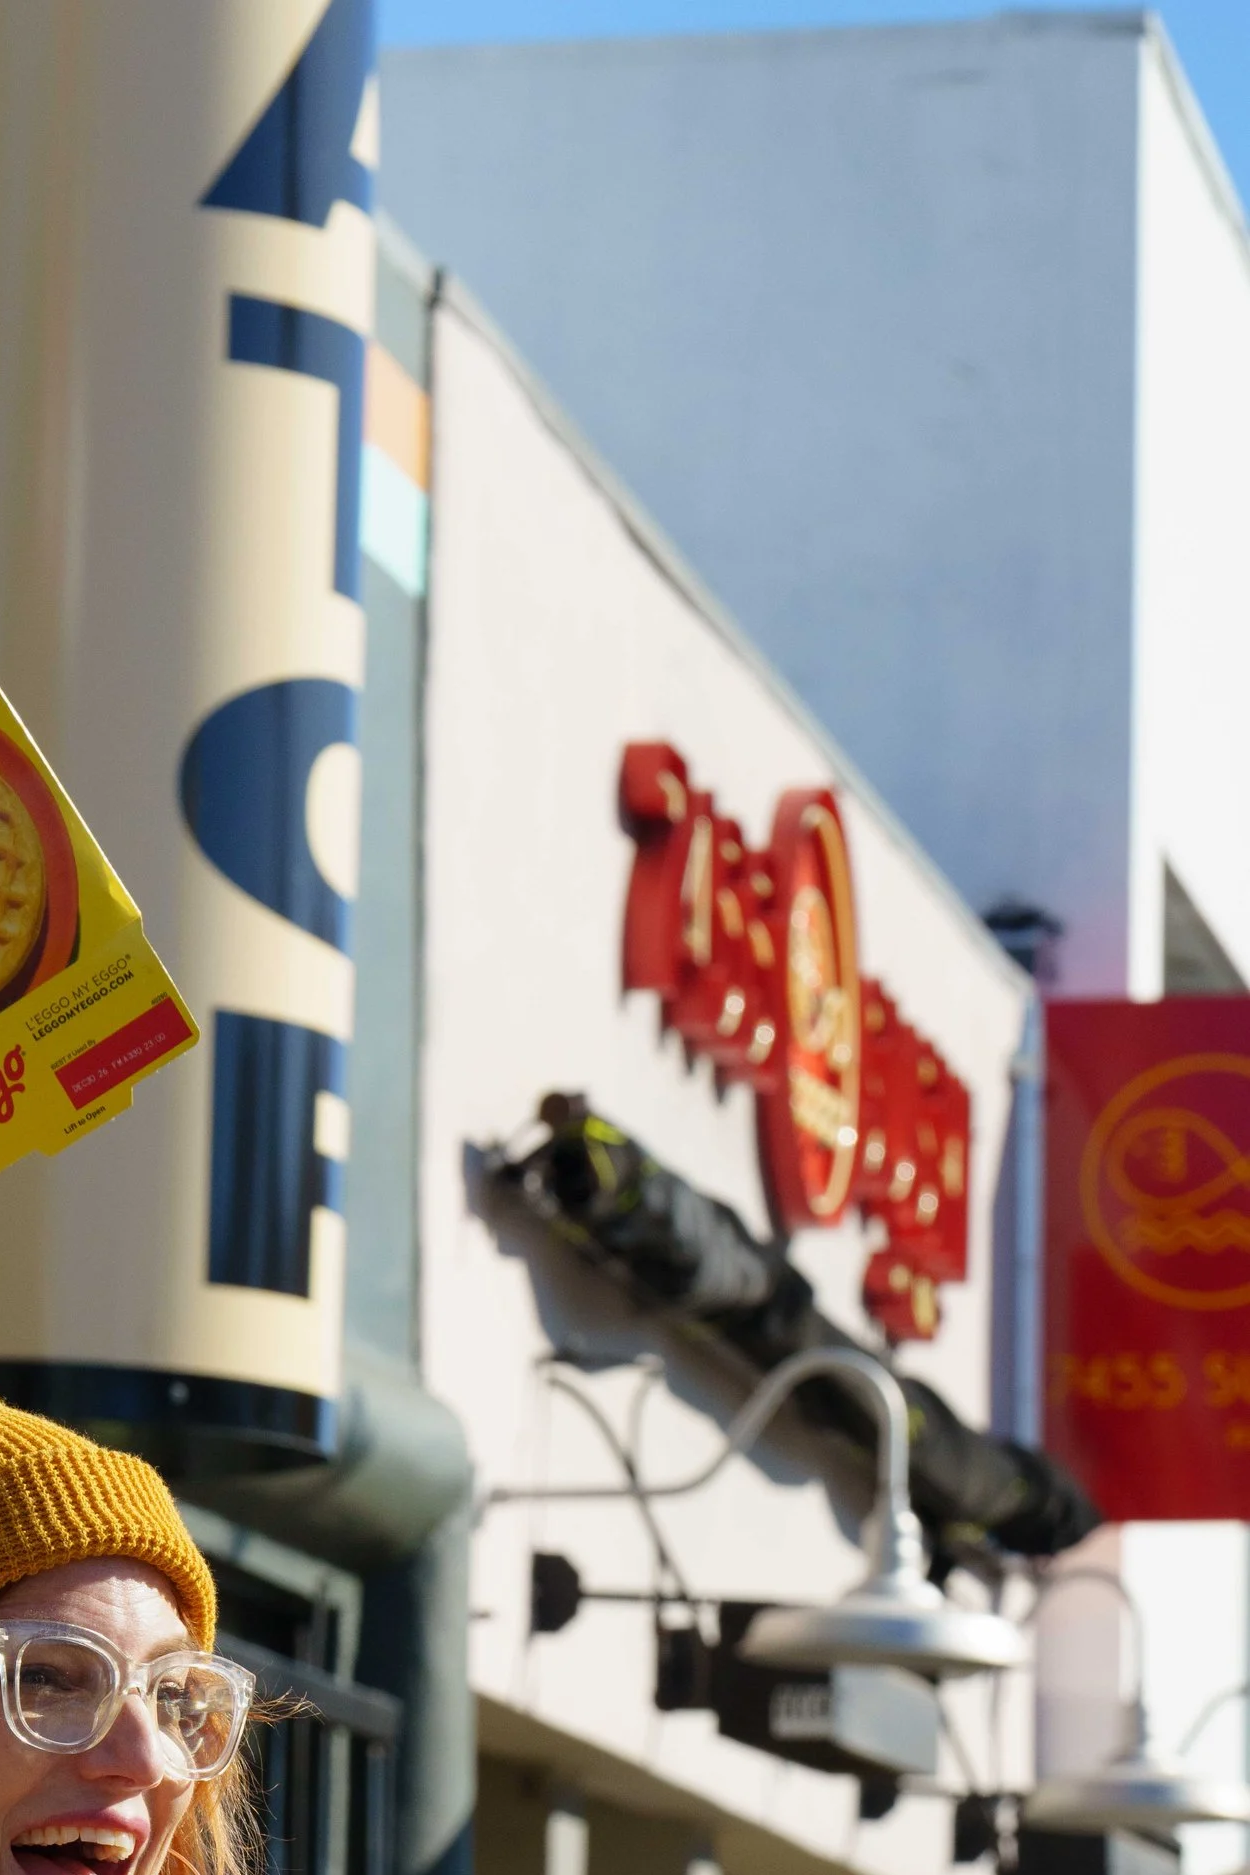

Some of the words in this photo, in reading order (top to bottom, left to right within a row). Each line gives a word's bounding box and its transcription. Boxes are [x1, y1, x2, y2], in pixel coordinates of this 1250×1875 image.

[24, 994, 72, 1031] L'EGGO
[70, 981, 93, 1001] MY
[31, 969, 135, 1042] LEGGOMYEGGO.COM
[50, 1056, 67, 1070] BEST
[70, 1043, 88, 1057] Used
[86, 1037, 96, 1047] By
[63, 1122, 78, 1135] Lift
[77, 1117, 86, 1126] to
[84, 1104, 107, 1122] Open
